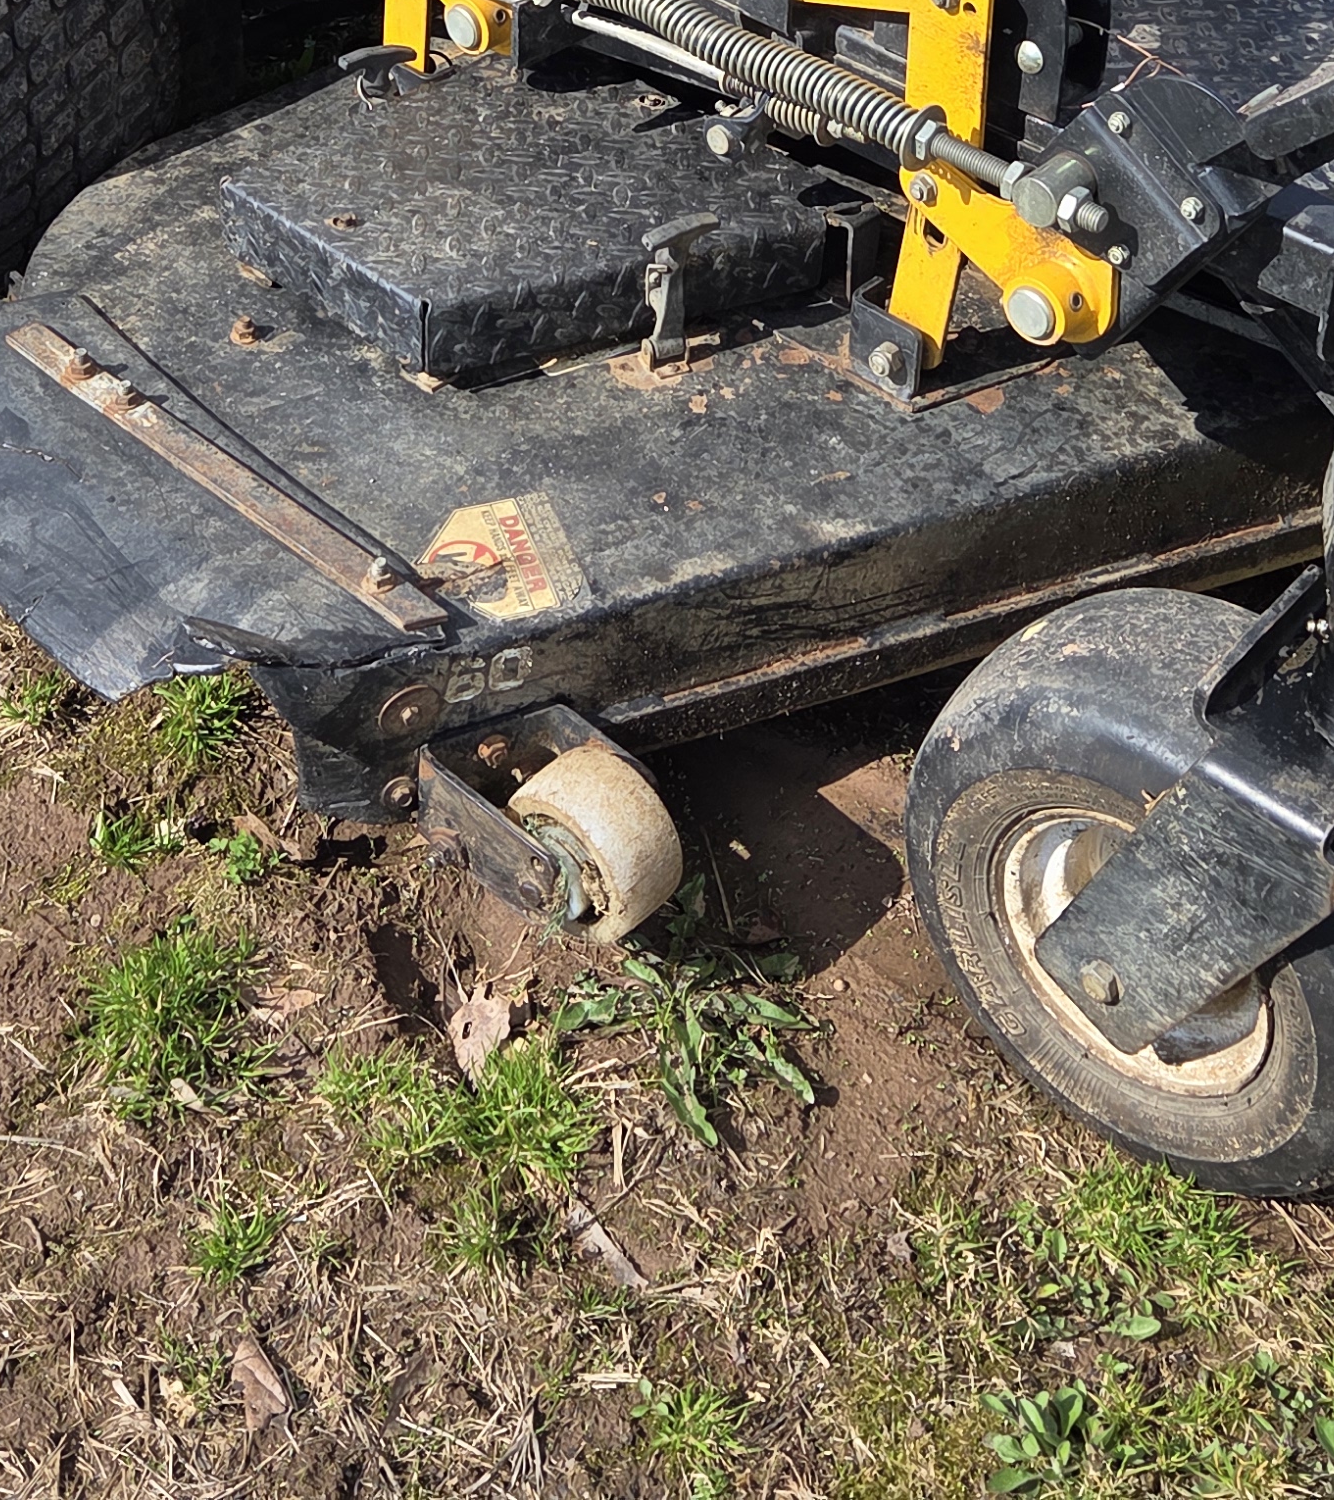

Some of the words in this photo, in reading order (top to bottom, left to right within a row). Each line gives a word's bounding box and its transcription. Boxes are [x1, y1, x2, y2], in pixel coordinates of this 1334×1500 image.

[481, 510, 496, 527] KEEP
[489, 527, 506, 551] HANDS
[499, 515, 547, 593] DANGER
[513, 585, 530, 607] AWAY
